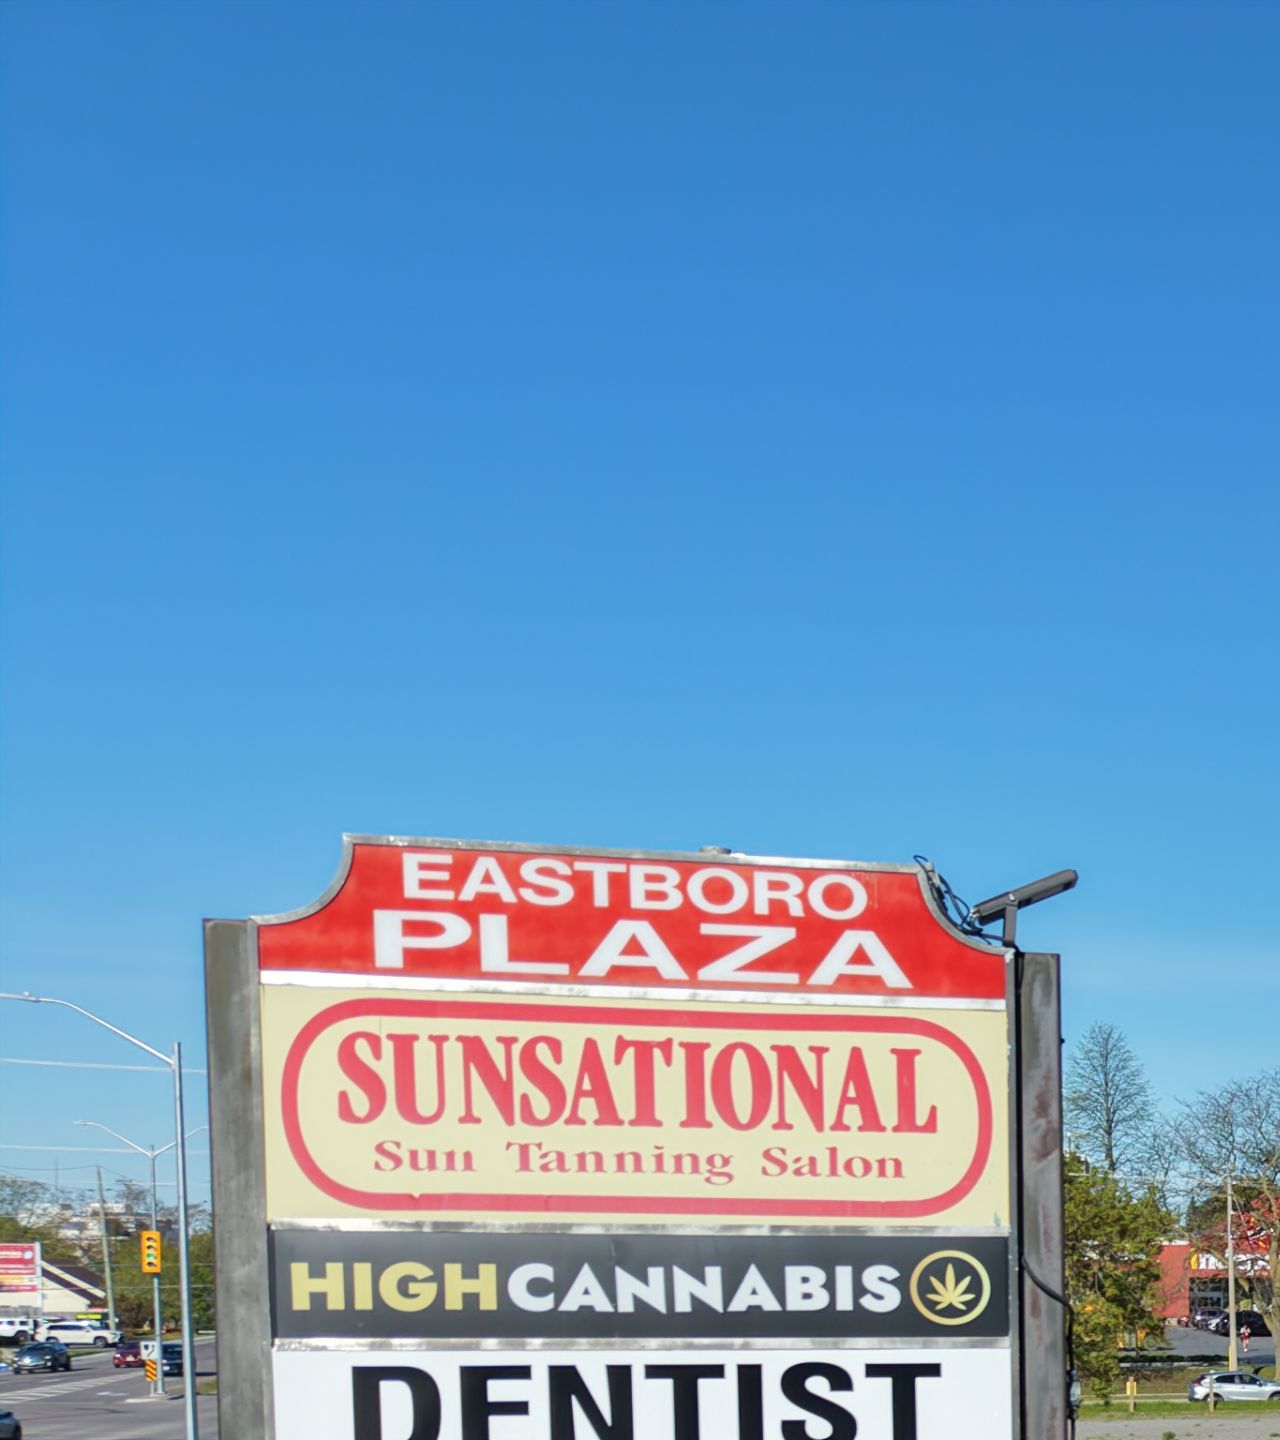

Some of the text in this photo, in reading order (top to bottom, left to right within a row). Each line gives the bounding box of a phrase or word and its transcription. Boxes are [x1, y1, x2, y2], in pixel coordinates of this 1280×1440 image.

[403, 853, 868, 919] EASTBORO
[373, 910, 913, 989] PLAZA
[337, 1031, 937, 1134] SUNSATIONAL
[375, 1140, 906, 1185] Sun Tanning Salon
